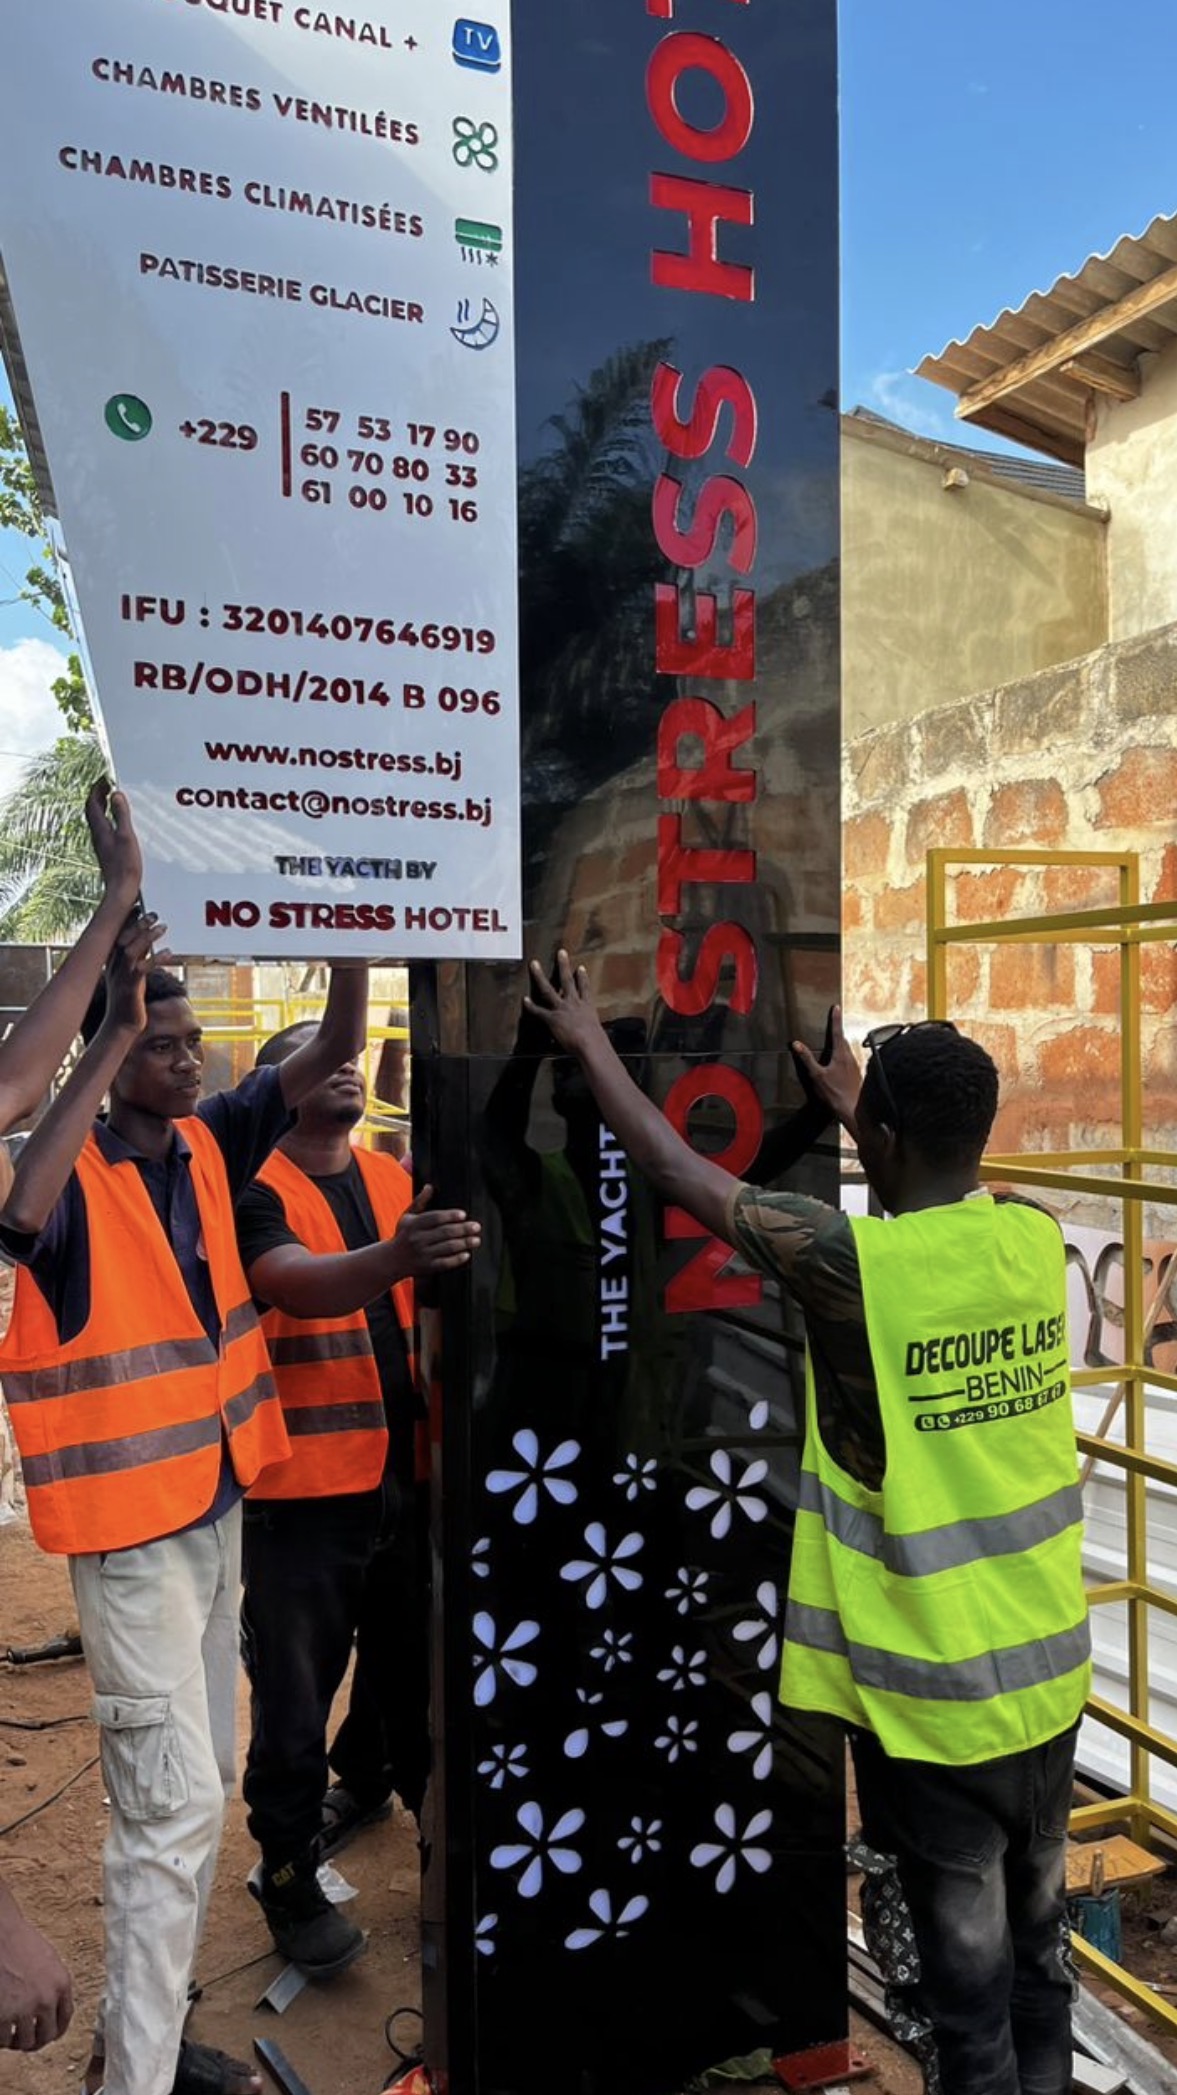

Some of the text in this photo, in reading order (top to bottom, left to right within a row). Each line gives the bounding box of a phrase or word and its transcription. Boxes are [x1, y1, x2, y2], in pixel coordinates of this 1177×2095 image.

[294, 8, 392, 48] CANAL
[404, 36, 418, 51] +
[463, 26, 494, 51] TV
[92, 57, 420, 146] CHAMBRES VENTILÉES
[59, 146, 424, 237] CHAMBRES CLIMATISÉES
[140, 252, 425, 324] PATISSERIE GLACIER
[179, 419, 259, 451] +229
[306, 408, 480, 455] 57 53 17 90
[300, 443, 478, 489] 60 70 80 33
[301, 479, 479, 523] 61 00 10 16
[121, 594, 186, 626] IFU
[222, 603, 496, 655] 3201407646919
[645, 0, 764, 1314] NO STRESS HO
[133, 660, 502, 716] RB/ODH/2014 B 096
[204, 741, 463, 781] www.nostress.bj
[175, 786, 493, 827] contact@nostress.bj
[275, 855, 437, 880] THE YACTH BY
[205, 900, 508, 933] NO STRESS HOTEL
[600, 1123, 629, 1361] THE YACHT
[905, 1323, 1016, 1377] DECOUPE
[965, 1362, 1045, 1402] BENIN
[953, 1409, 984, 1426] +229
[987, 1402, 1010, 1419] 90
[1014, 1397, 1034, 1412] 68
[272, 1861, 295, 1887] CAT
